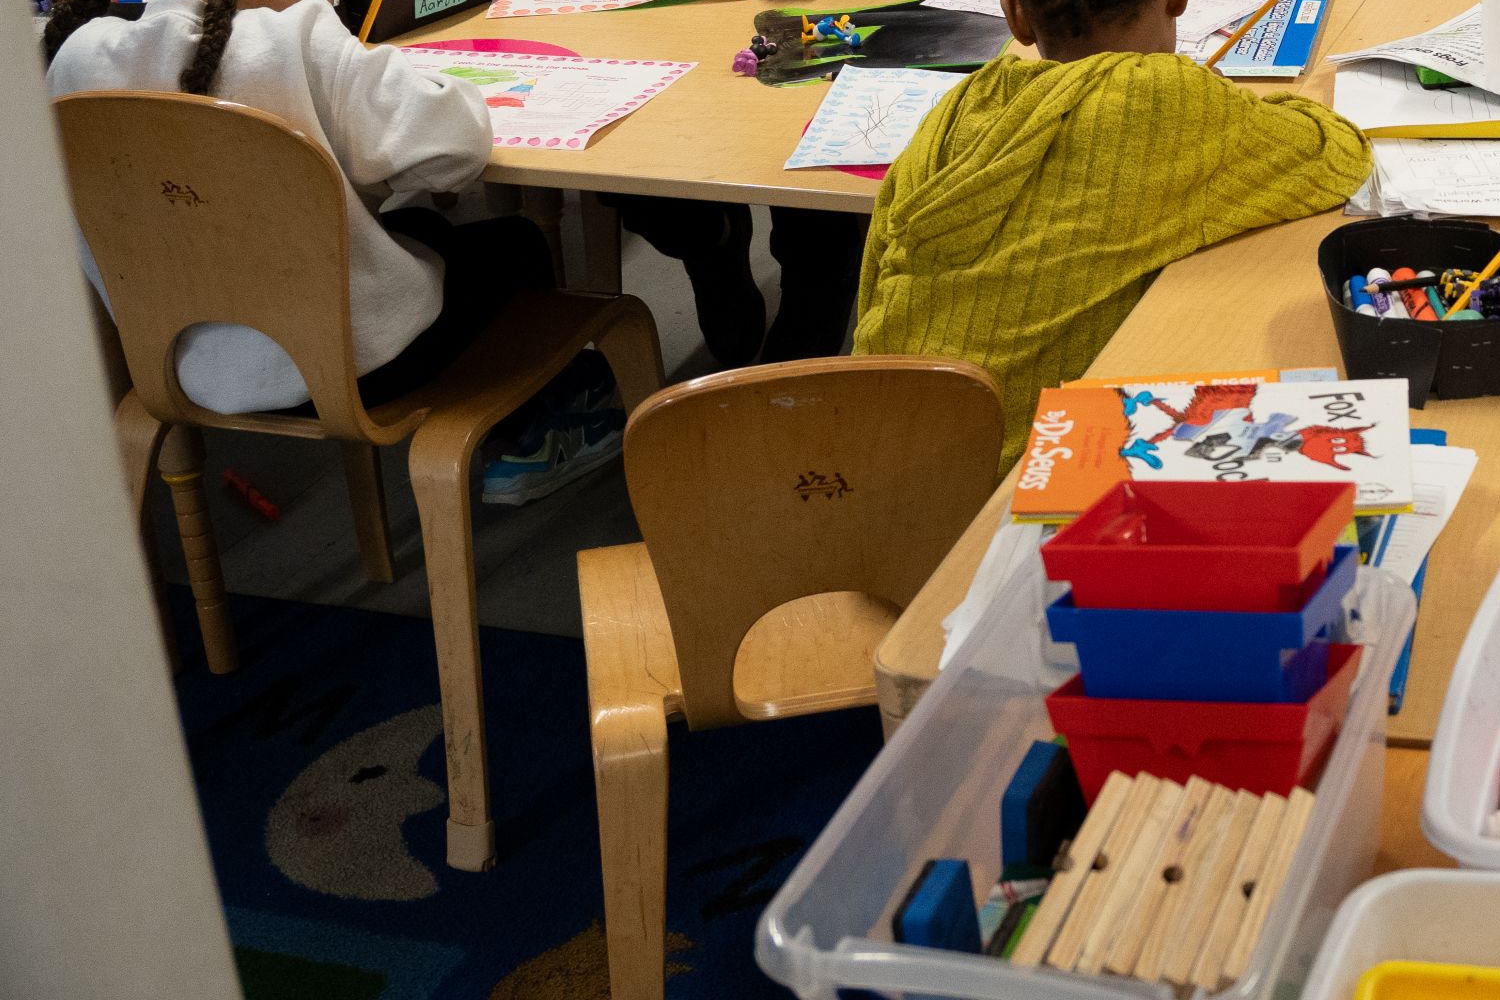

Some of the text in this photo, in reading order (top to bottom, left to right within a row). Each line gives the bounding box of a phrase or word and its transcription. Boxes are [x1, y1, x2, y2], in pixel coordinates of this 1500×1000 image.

[1433, 53, 1468, 67] Frogs
[1035, 418, 1074, 449] Dr.
[1018, 447, 1073, 492] Seuss
